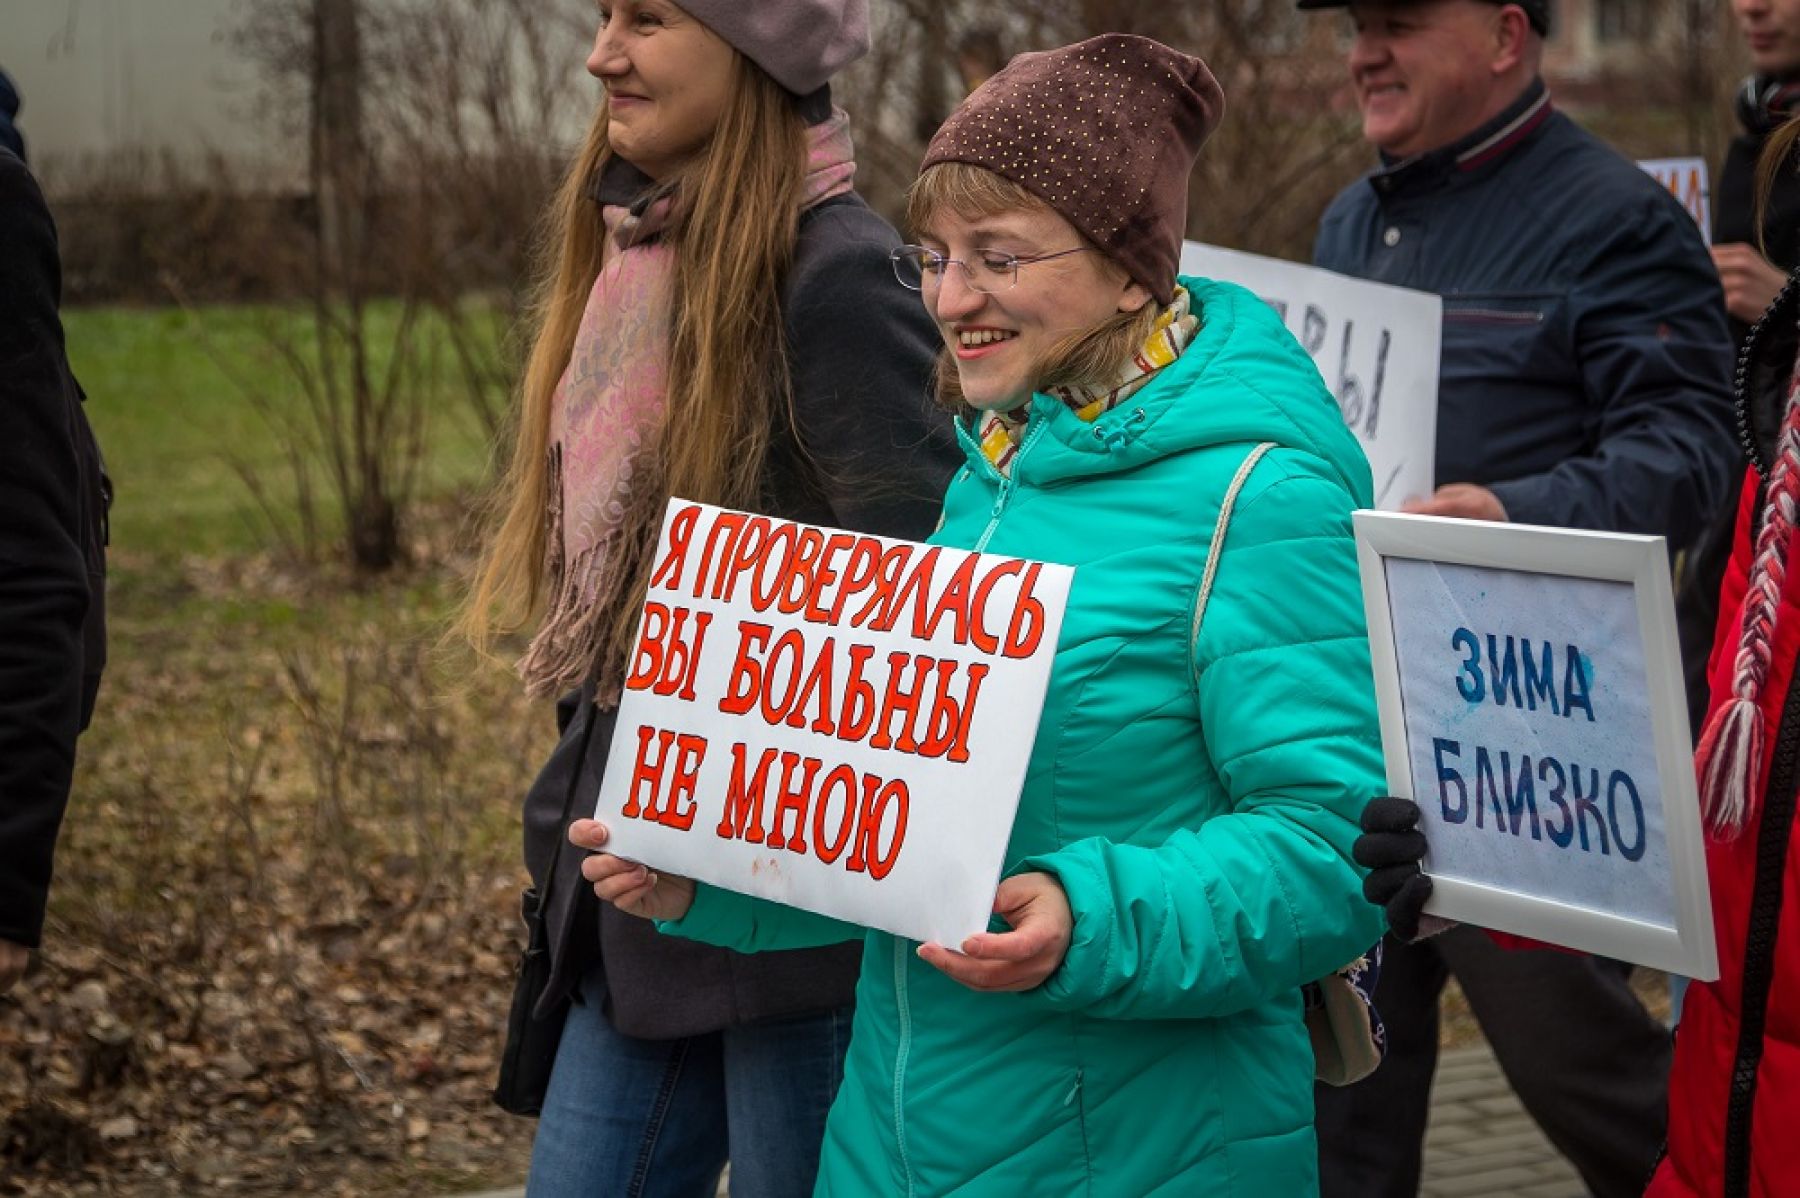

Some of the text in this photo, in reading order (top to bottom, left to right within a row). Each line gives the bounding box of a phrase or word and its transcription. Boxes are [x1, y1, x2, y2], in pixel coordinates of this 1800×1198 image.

[651, 506, 1046, 659] Я ПРОВЕРЯЛАСЬ
[626, 602, 989, 763] ВЫ БОЛЬНЫ
[1452, 627, 1595, 722] ЗИМА
[622, 725, 911, 881] НЕ МНОЮ
[1433, 737, 1646, 862] БЛИЗКО
